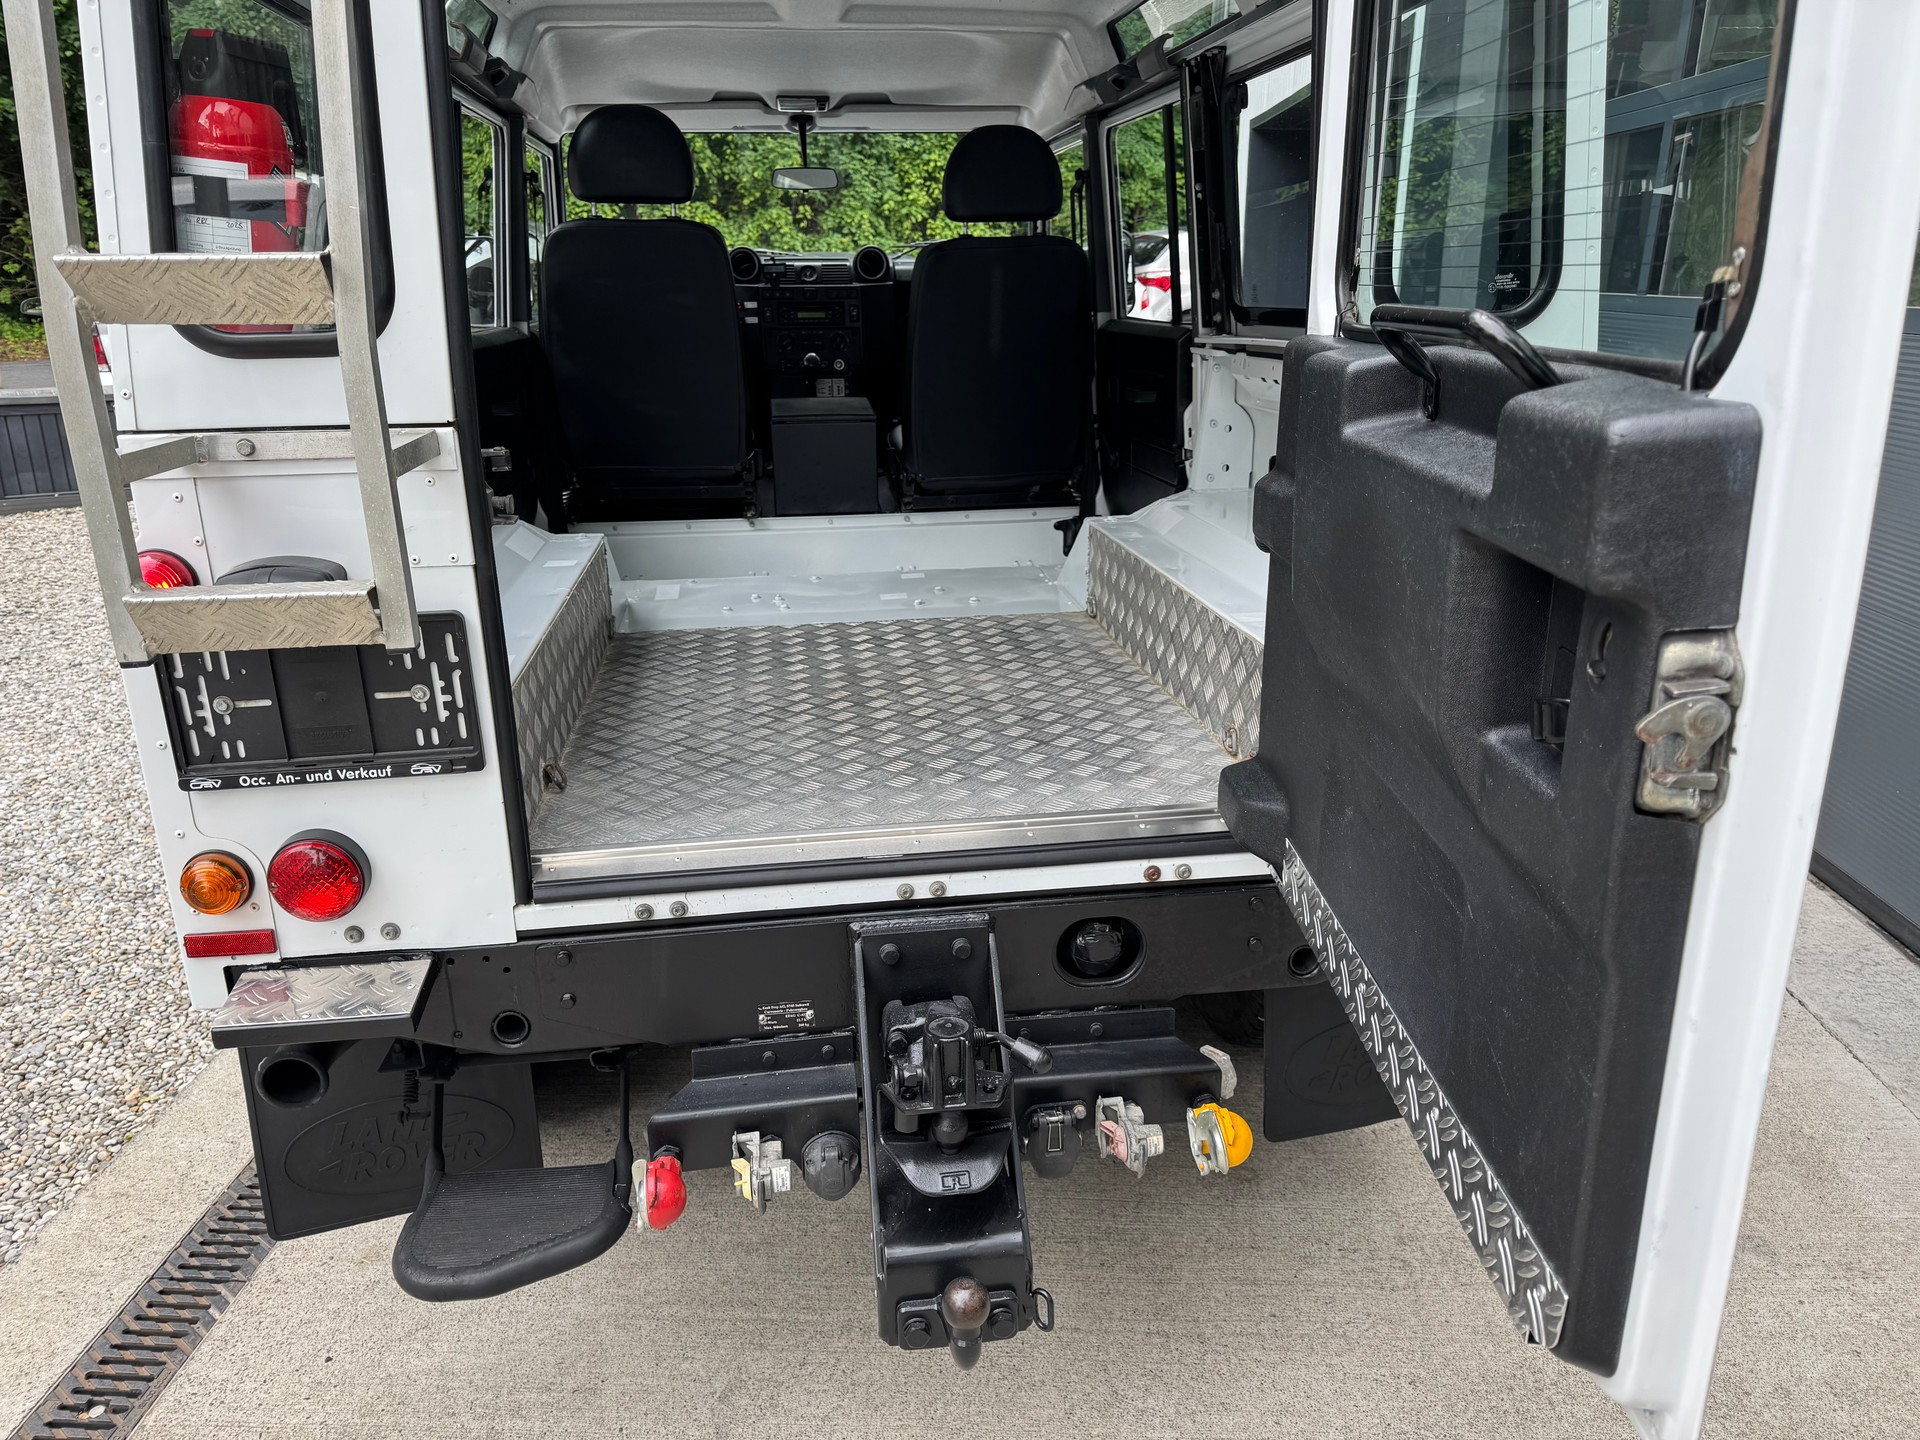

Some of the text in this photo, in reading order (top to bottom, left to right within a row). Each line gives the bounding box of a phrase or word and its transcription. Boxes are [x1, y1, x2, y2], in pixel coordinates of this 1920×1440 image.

[239, 775, 271, 787] Occ.
[275, 773, 301, 785] An-
[305, 769, 333, 783] und
[336, 765, 393, 780] Verkauf
[328, 1110, 442, 1154] LAN
